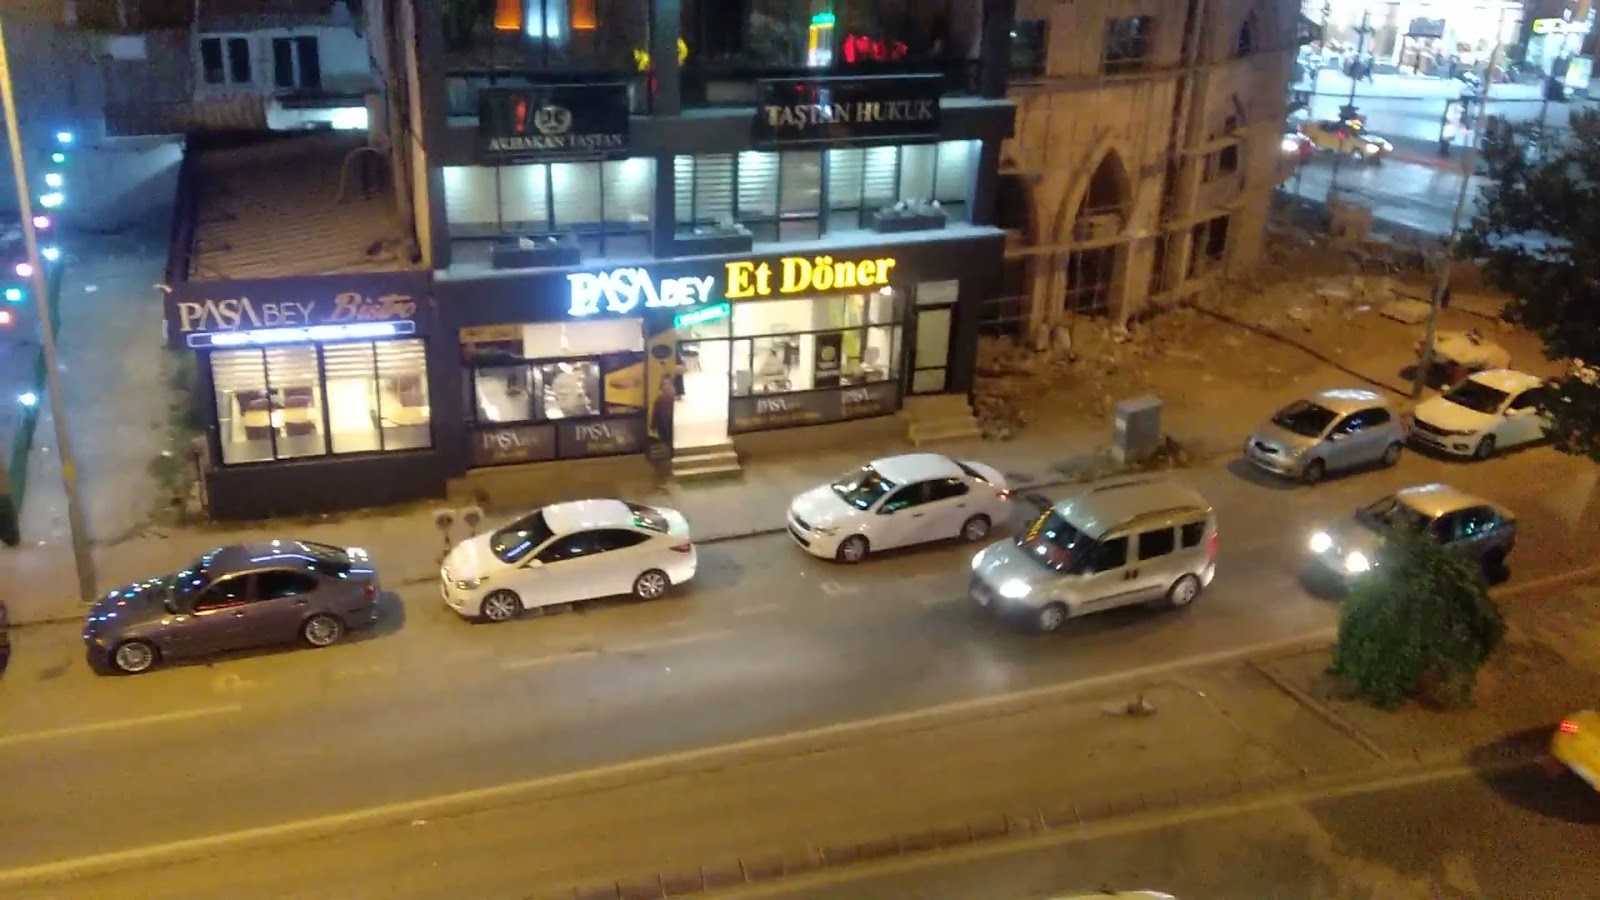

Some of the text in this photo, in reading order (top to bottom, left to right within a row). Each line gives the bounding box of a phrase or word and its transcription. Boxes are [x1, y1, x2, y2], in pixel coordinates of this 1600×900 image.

[764, 100, 932, 130] TAŞTAN HUKUK
[659, 276, 715, 307] BEY
[724, 255, 897, 299] Et Döner
[261, 302, 316, 327] BEY
